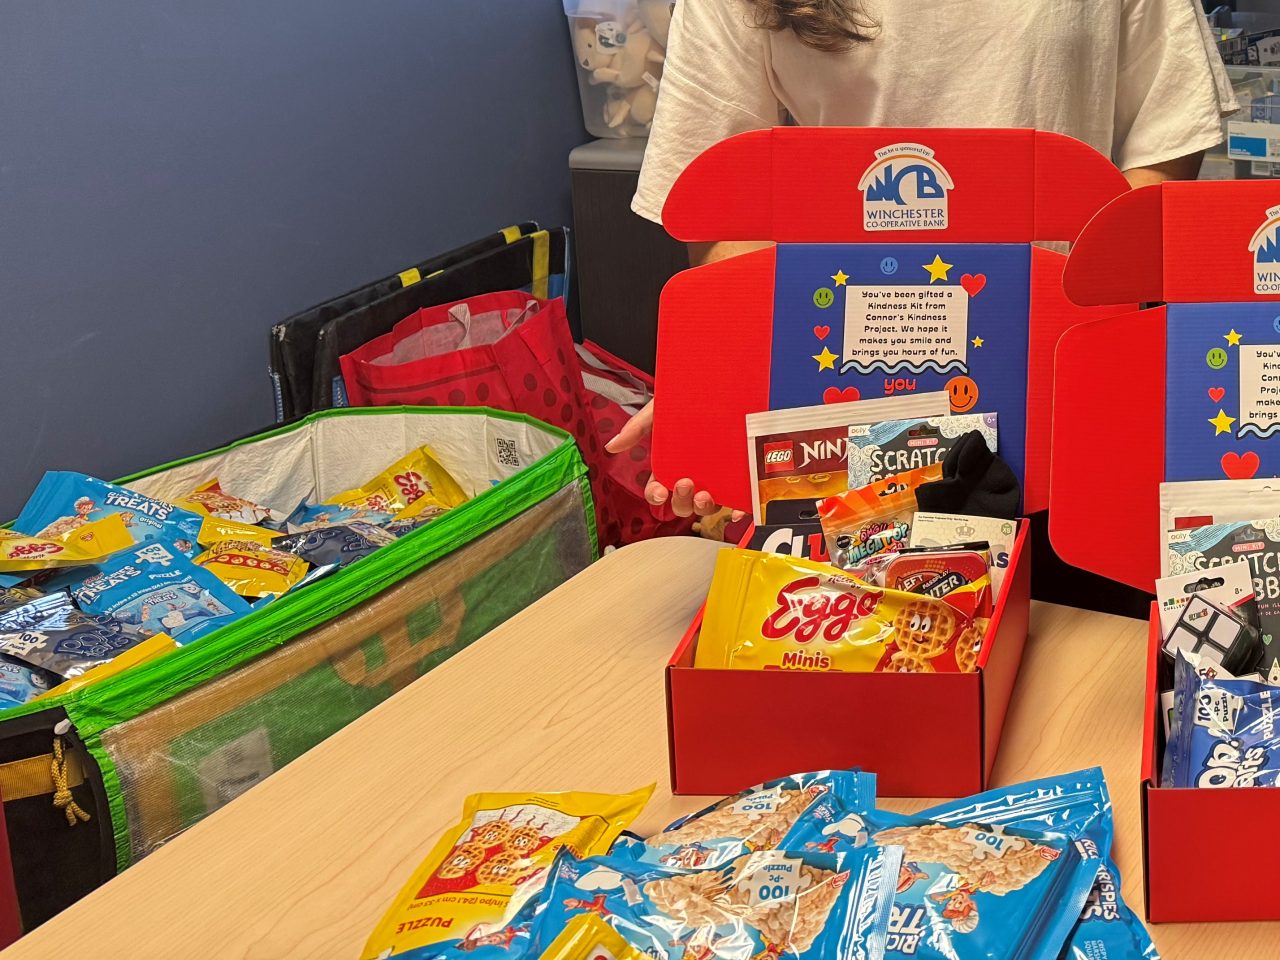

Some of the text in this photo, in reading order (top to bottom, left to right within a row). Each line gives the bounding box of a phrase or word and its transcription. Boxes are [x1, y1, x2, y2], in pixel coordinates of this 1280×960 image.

[866, 209, 944, 219] WINCHESTER
[918, 291, 940, 299] gifted
[864, 325, 898, 334] Project.
[884, 378, 916, 395] you
[1249, 411, 1278, 419] brings
[764, 448, 792, 464] LEGO
[104, 496, 168, 520] TREATS
[142, 545, 161, 555] 100
[848, 537, 883, 564] MEGA
[149, 570, 182, 579] PUZZLE
[79, 570, 142, 604] TREATS
[761, 576, 884, 643] Eggo
[18, 632, 39, 643] 100
[782, 650, 829, 670] Minis
[1198, 695, 1211, 721] 100
[1260, 691, 1273, 740] PUZZLE
[975, 833, 1004, 851] 100
[759, 885, 789, 899] 100
[396, 917, 454, 934] PUZZLE
